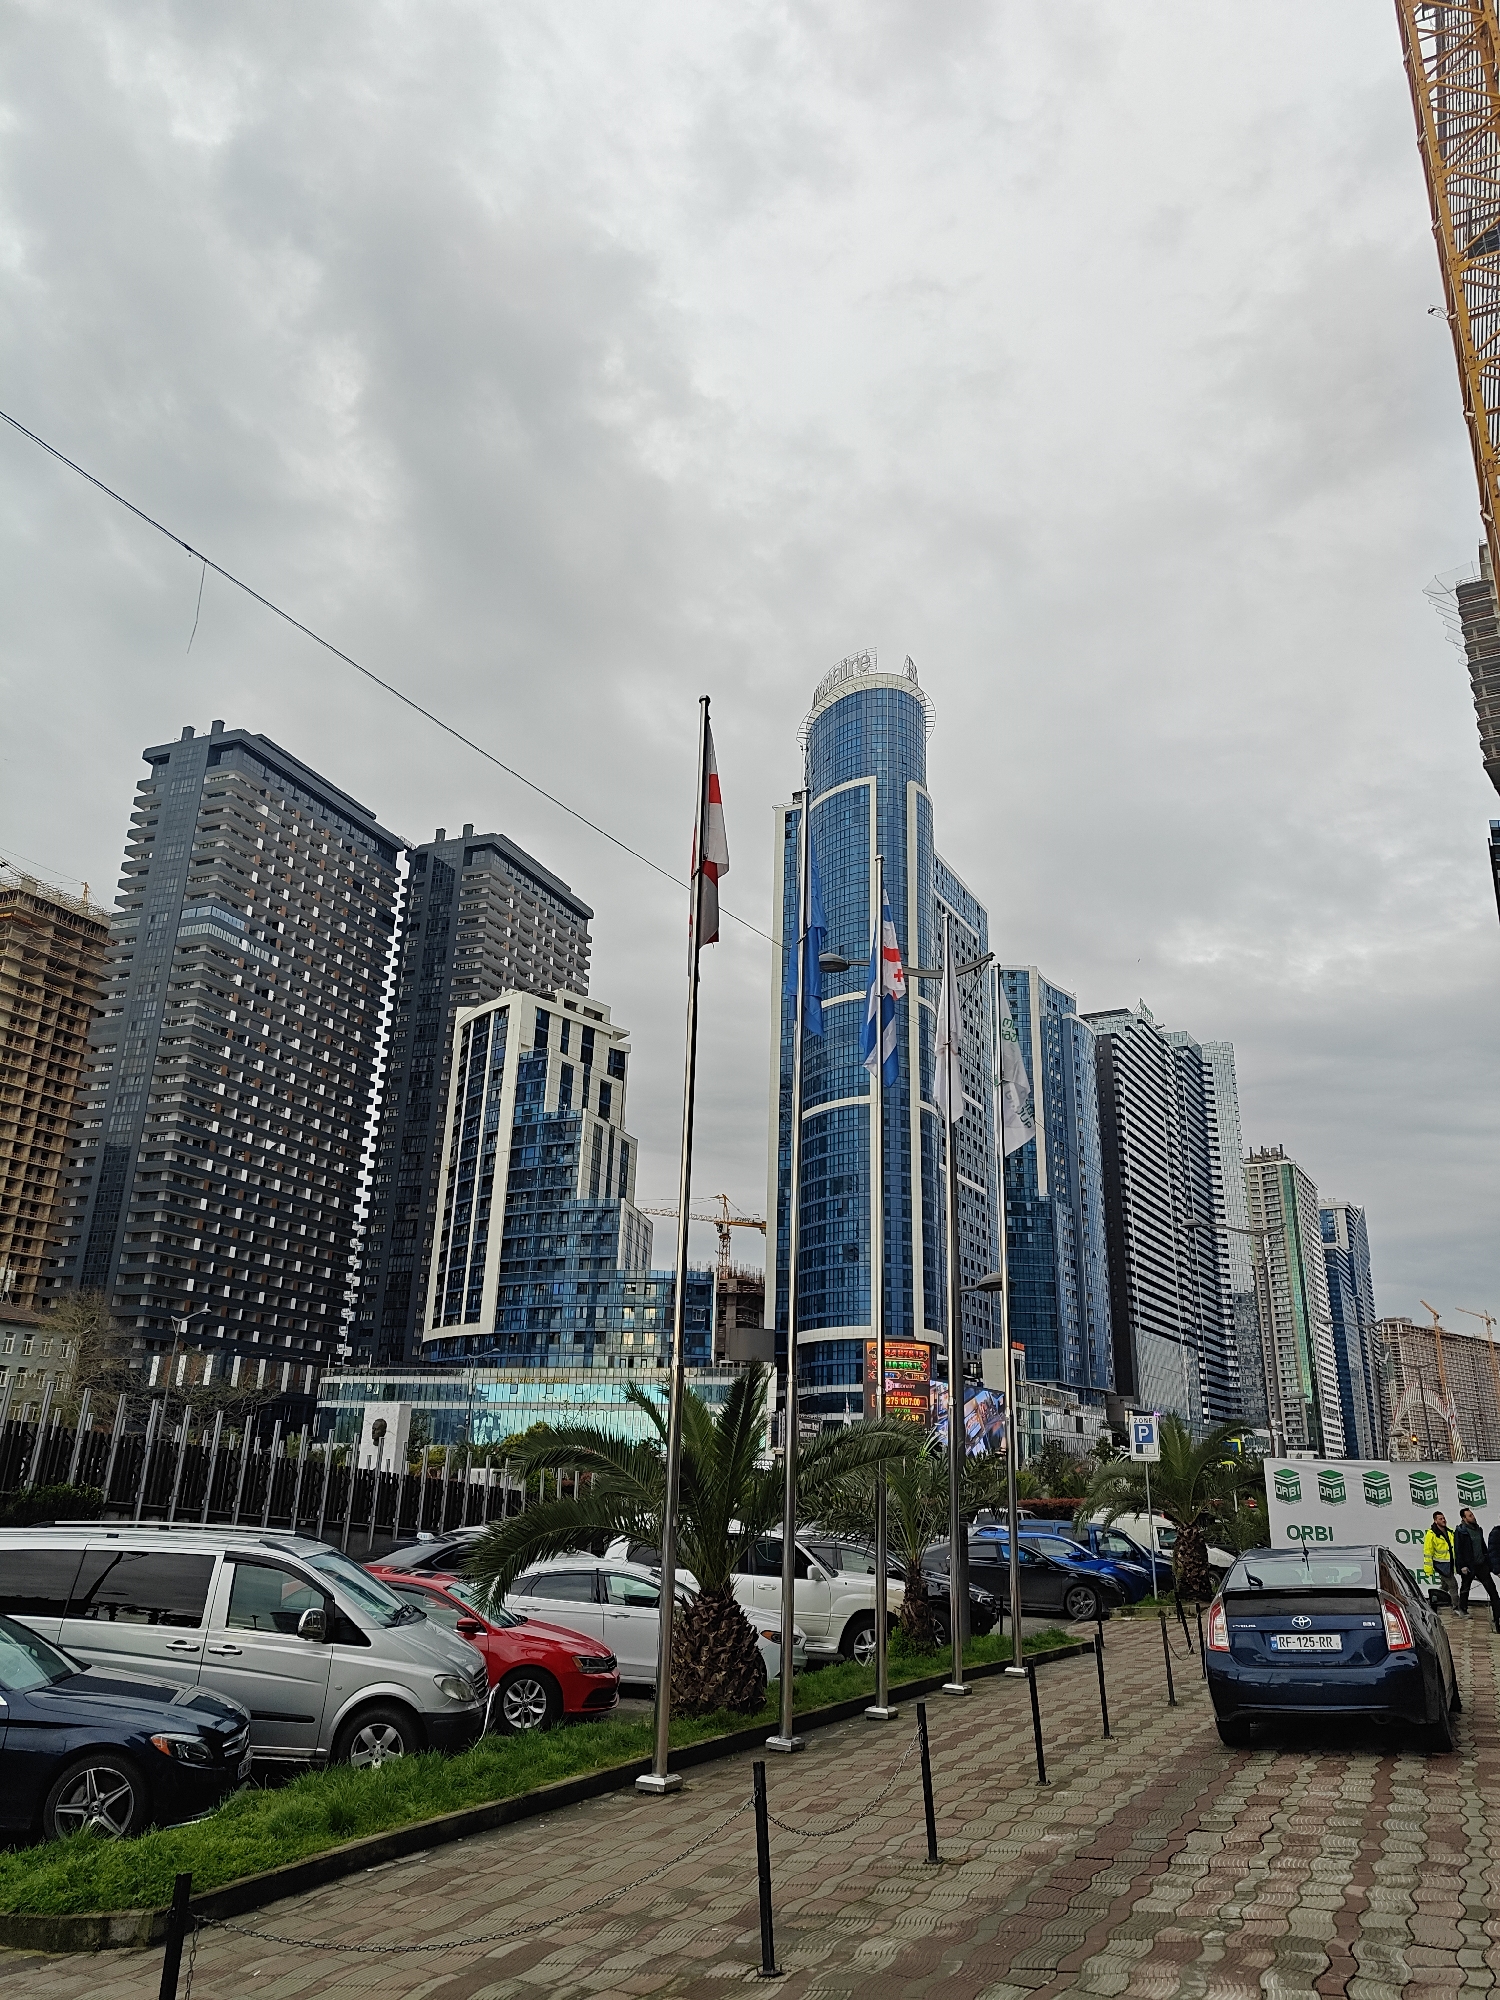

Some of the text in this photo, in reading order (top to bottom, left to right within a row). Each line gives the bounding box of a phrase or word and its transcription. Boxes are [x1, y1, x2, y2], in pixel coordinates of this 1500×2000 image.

[1275, 1484, 1301, 1498] ORBI
[1319, 1485, 1345, 1499] ORBI
[1364, 1486, 1391, 1500] ORBI
[1410, 1487, 1439, 1501] ORBI
[1457, 1488, 1486, 1502] ORBI
[1286, 1524, 1334, 1542] ORBI
[1395, 1528, 1426, 1545] OR
[1278, 1636, 1334, 1648] RF-125-RR
